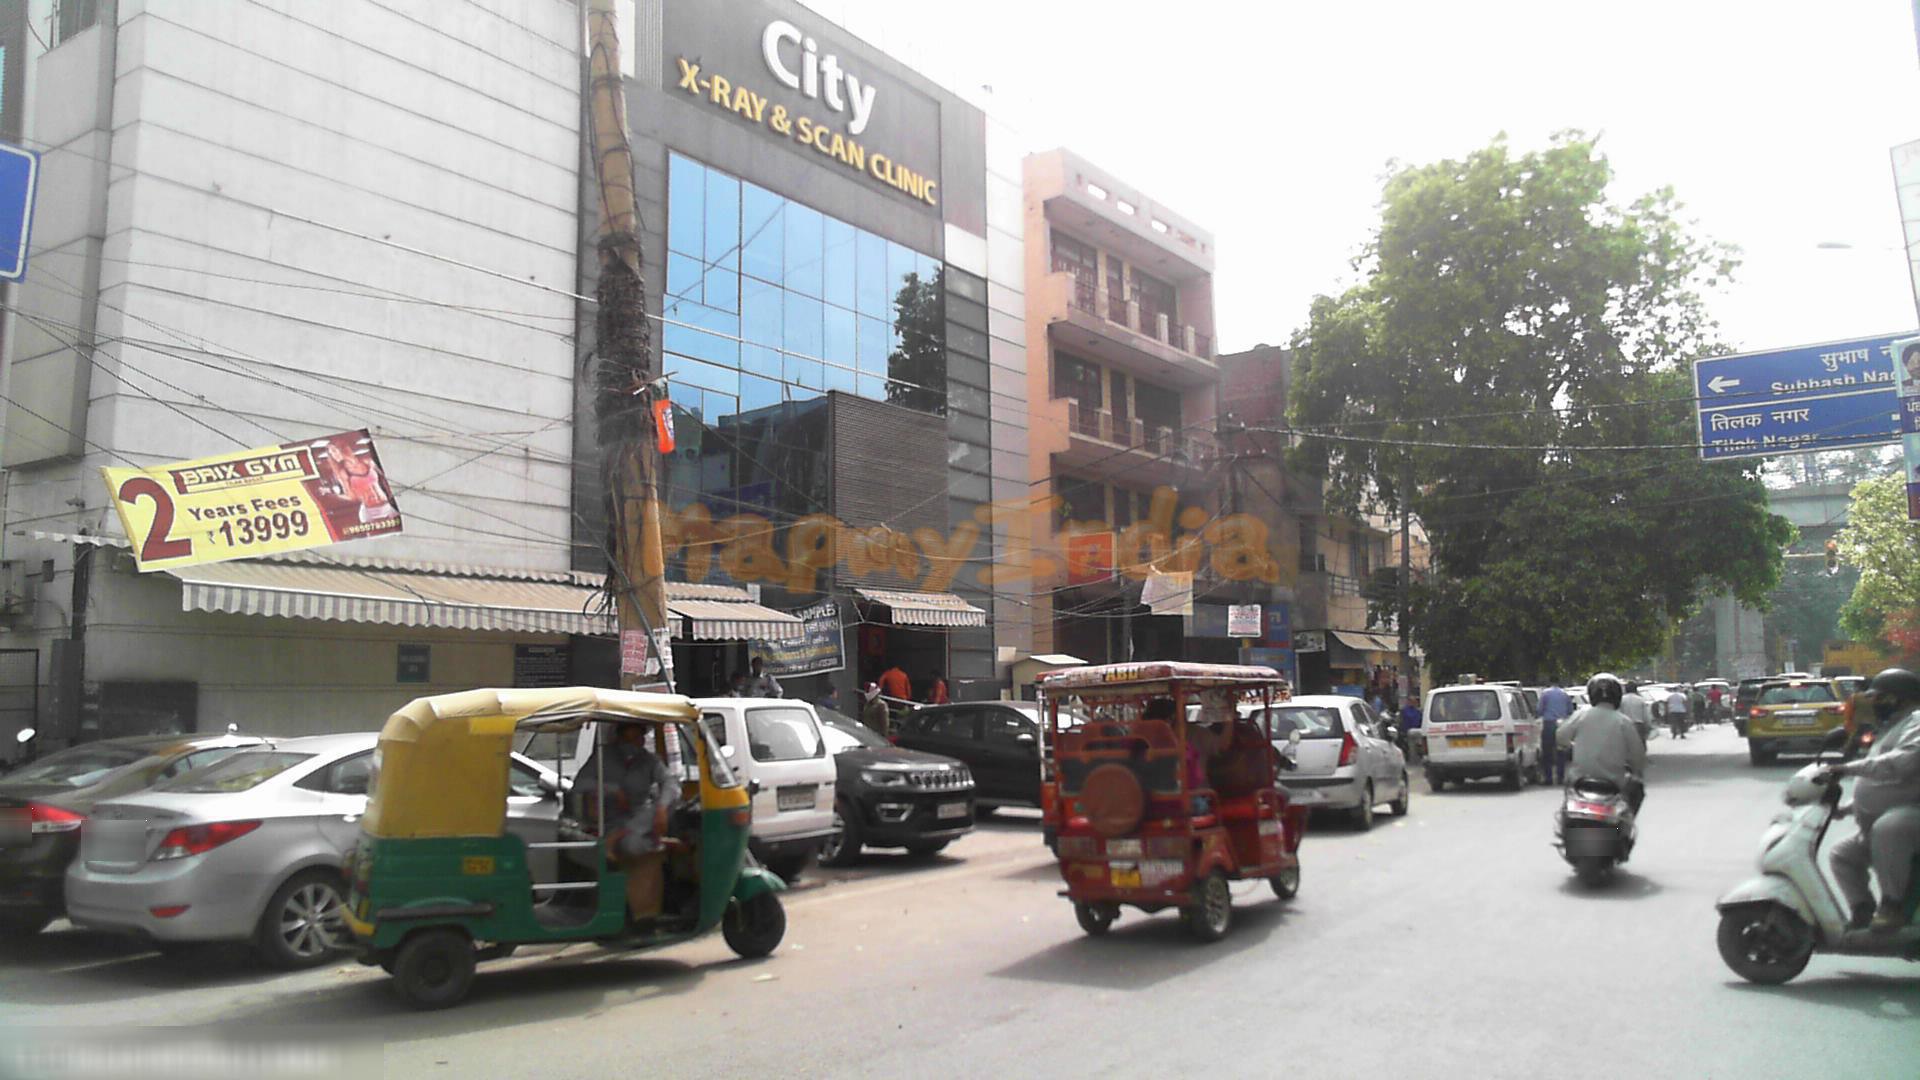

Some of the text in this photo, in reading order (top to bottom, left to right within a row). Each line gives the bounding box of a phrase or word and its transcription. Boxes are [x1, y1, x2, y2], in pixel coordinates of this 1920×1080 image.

[761, 20, 876, 135] City
[677, 57, 937, 206] X-RAY & SCAN CLINIC
[1820, 348, 1869, 372] सुभाष
[1771, 373, 1856, 396] Subhash
[1711, 408, 1810, 432] तिलक नगर
[244, 452, 301, 475] GYM
[118, 476, 193, 562] 2
[187, 494, 301, 522] Years Fees
